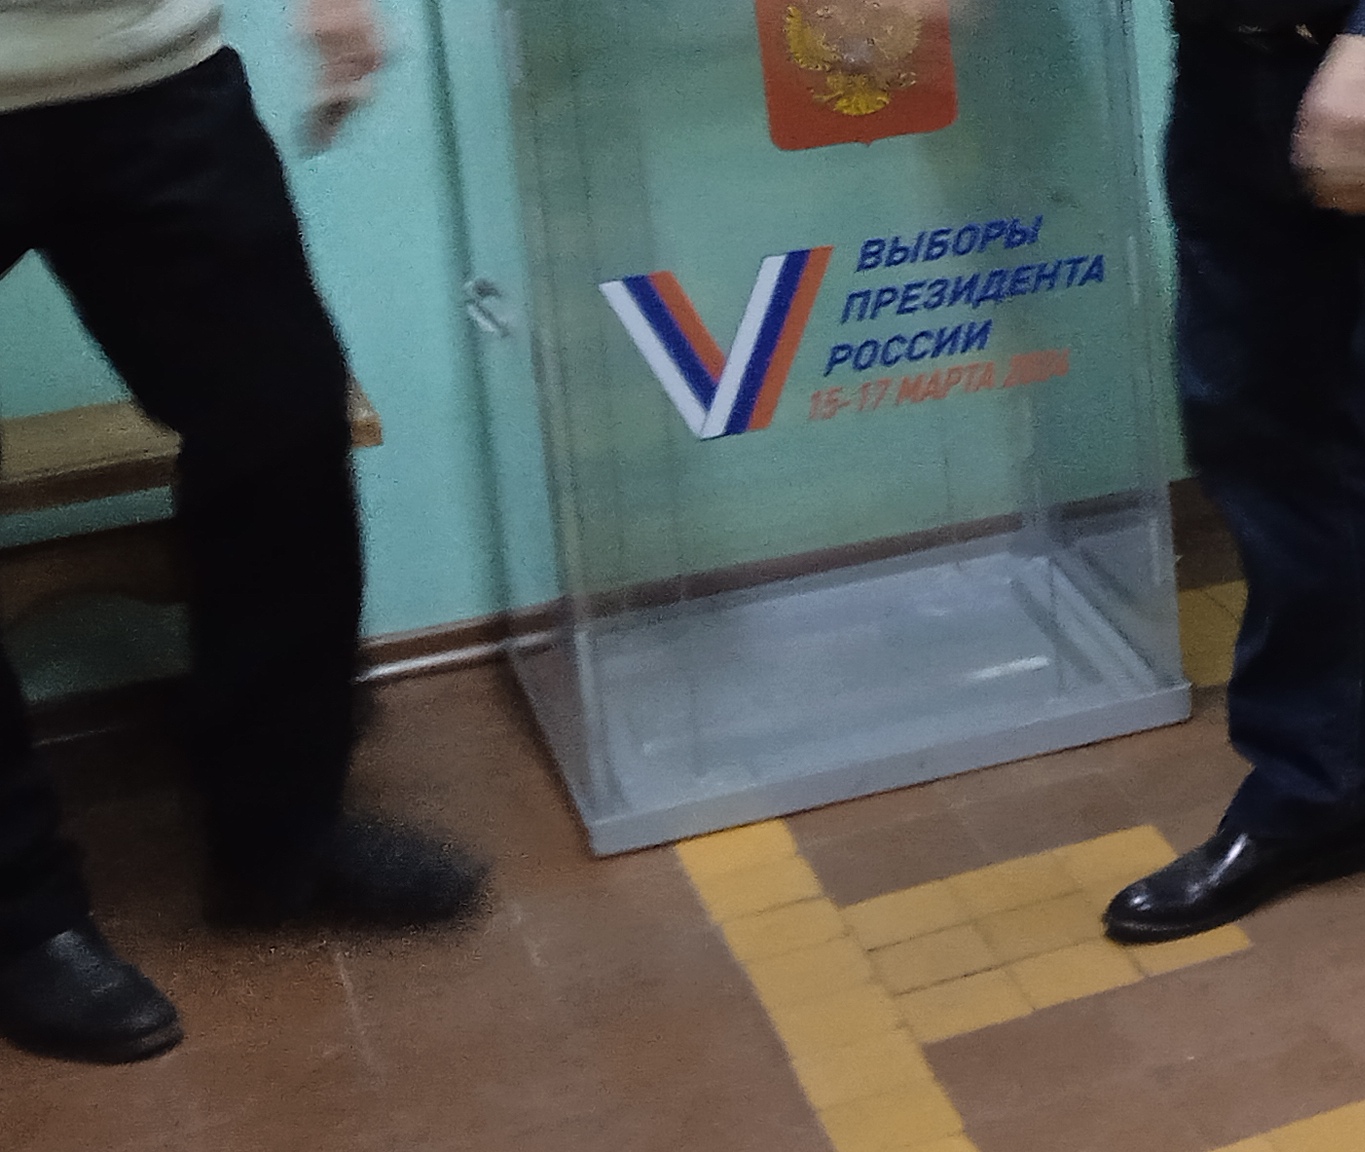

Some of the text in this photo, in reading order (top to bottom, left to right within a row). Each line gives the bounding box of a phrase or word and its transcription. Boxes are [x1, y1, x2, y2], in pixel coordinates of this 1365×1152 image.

[855, 214, 1044, 273] ВЫБОРЫ
[841, 254, 1105, 325] ПРЕЗИДЕНТА
[824, 318, 993, 377] РОССИИ
[896, 361, 997, 406] МАРТА
